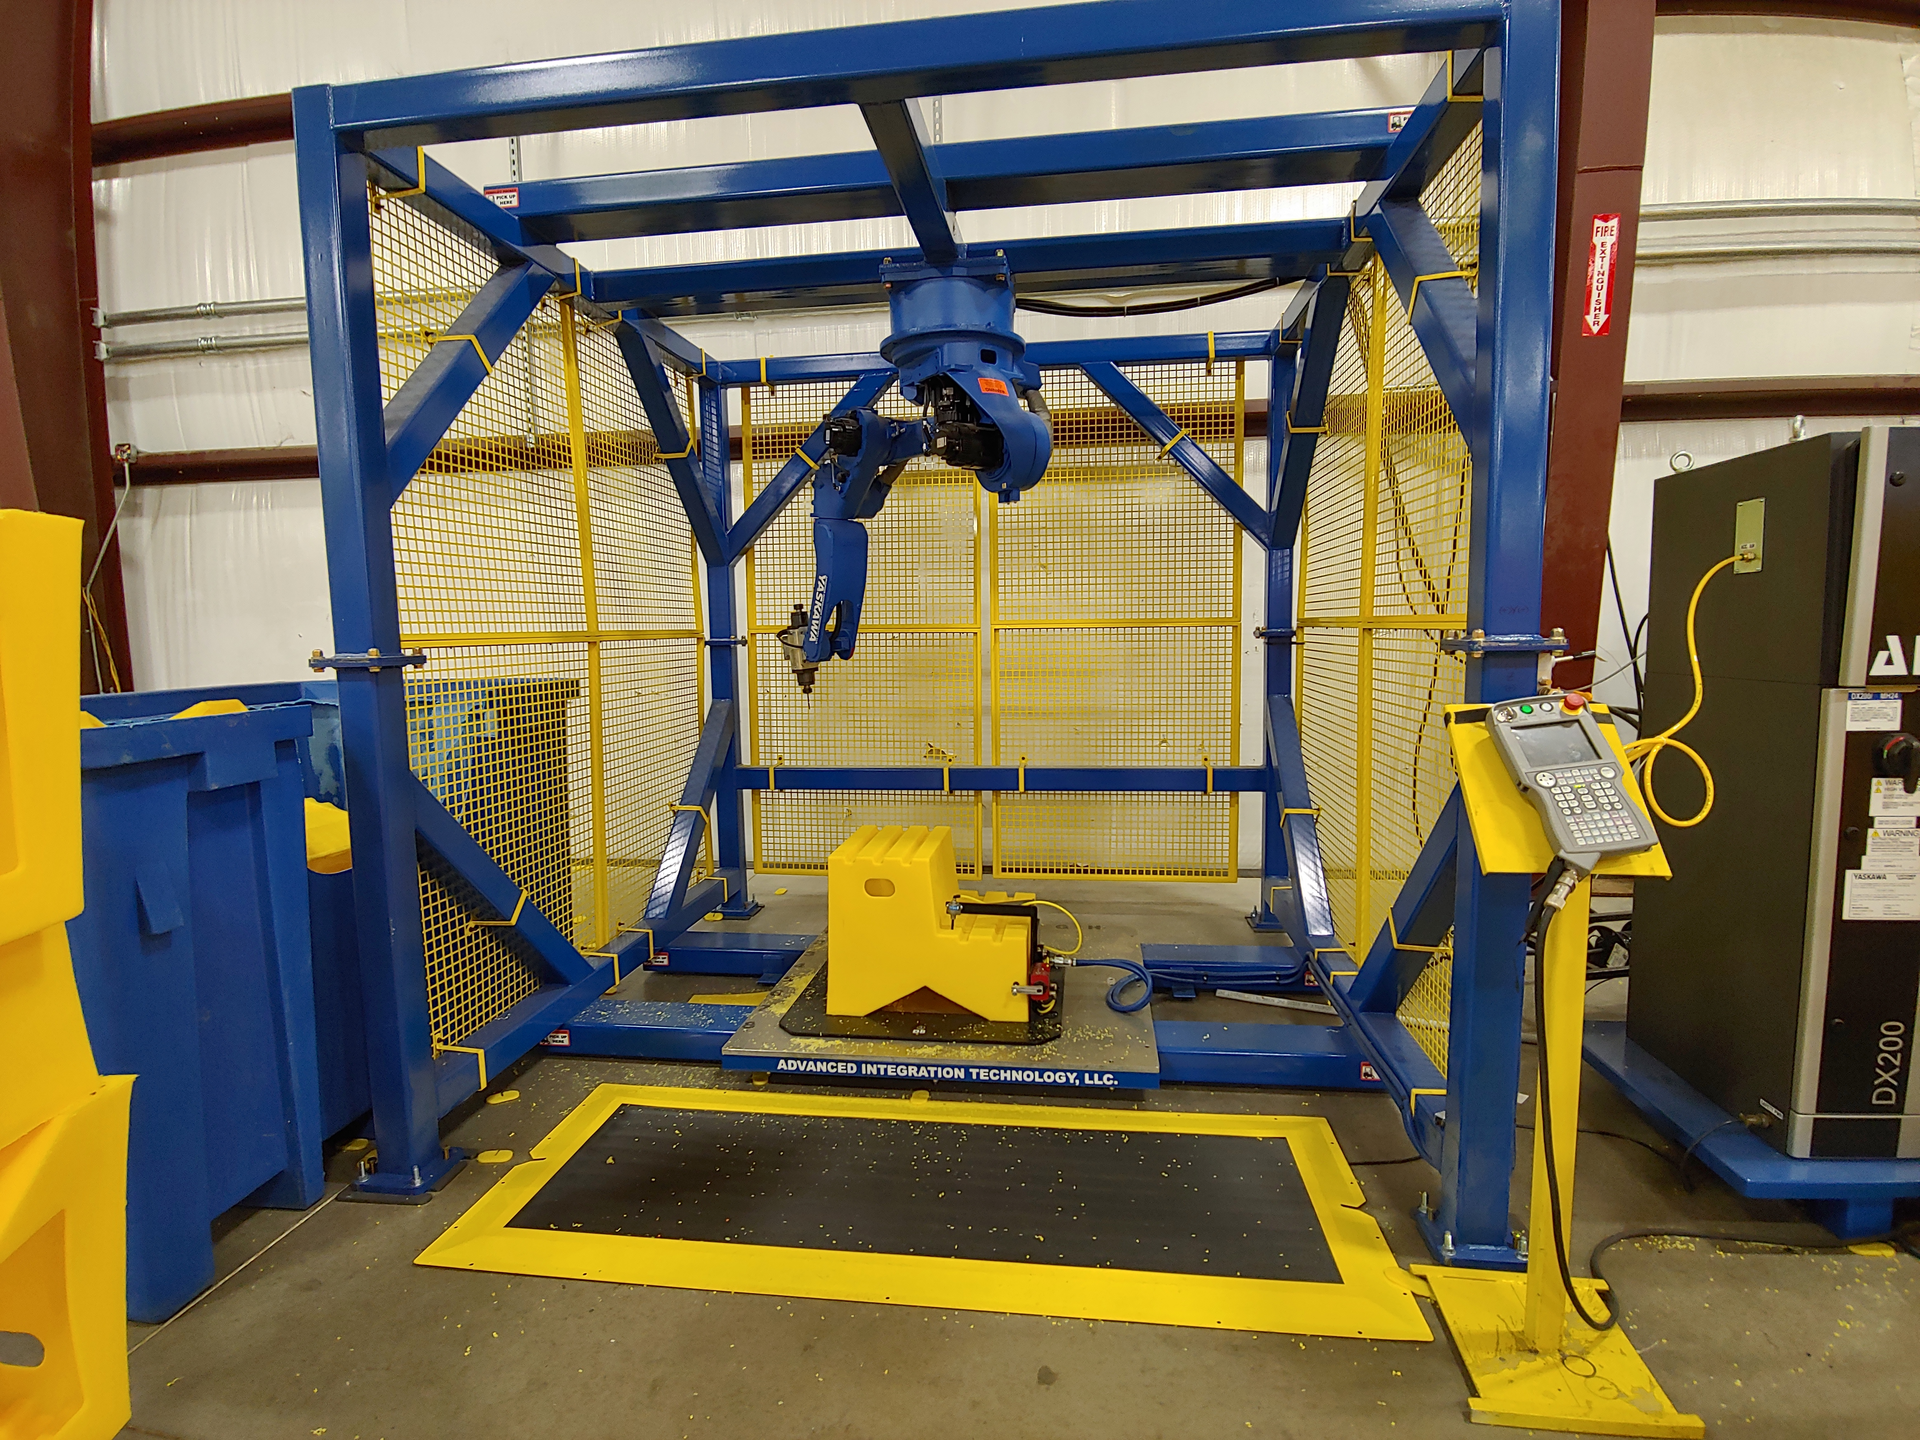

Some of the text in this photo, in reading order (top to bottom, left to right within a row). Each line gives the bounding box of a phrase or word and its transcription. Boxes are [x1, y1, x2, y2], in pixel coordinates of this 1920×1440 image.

[1595, 225, 1615, 237] FIRE
[1592, 241, 1608, 327] EXTINGUISHER
[809, 575, 828, 642] YASKAWA
[1882, 829, 1919, 837] WARNING
[777, 1059, 1119, 1086] ADVANCED INTEGRATION TECHNOLOGY, LLC.
[1872, 1021, 1905, 1104] DX200
